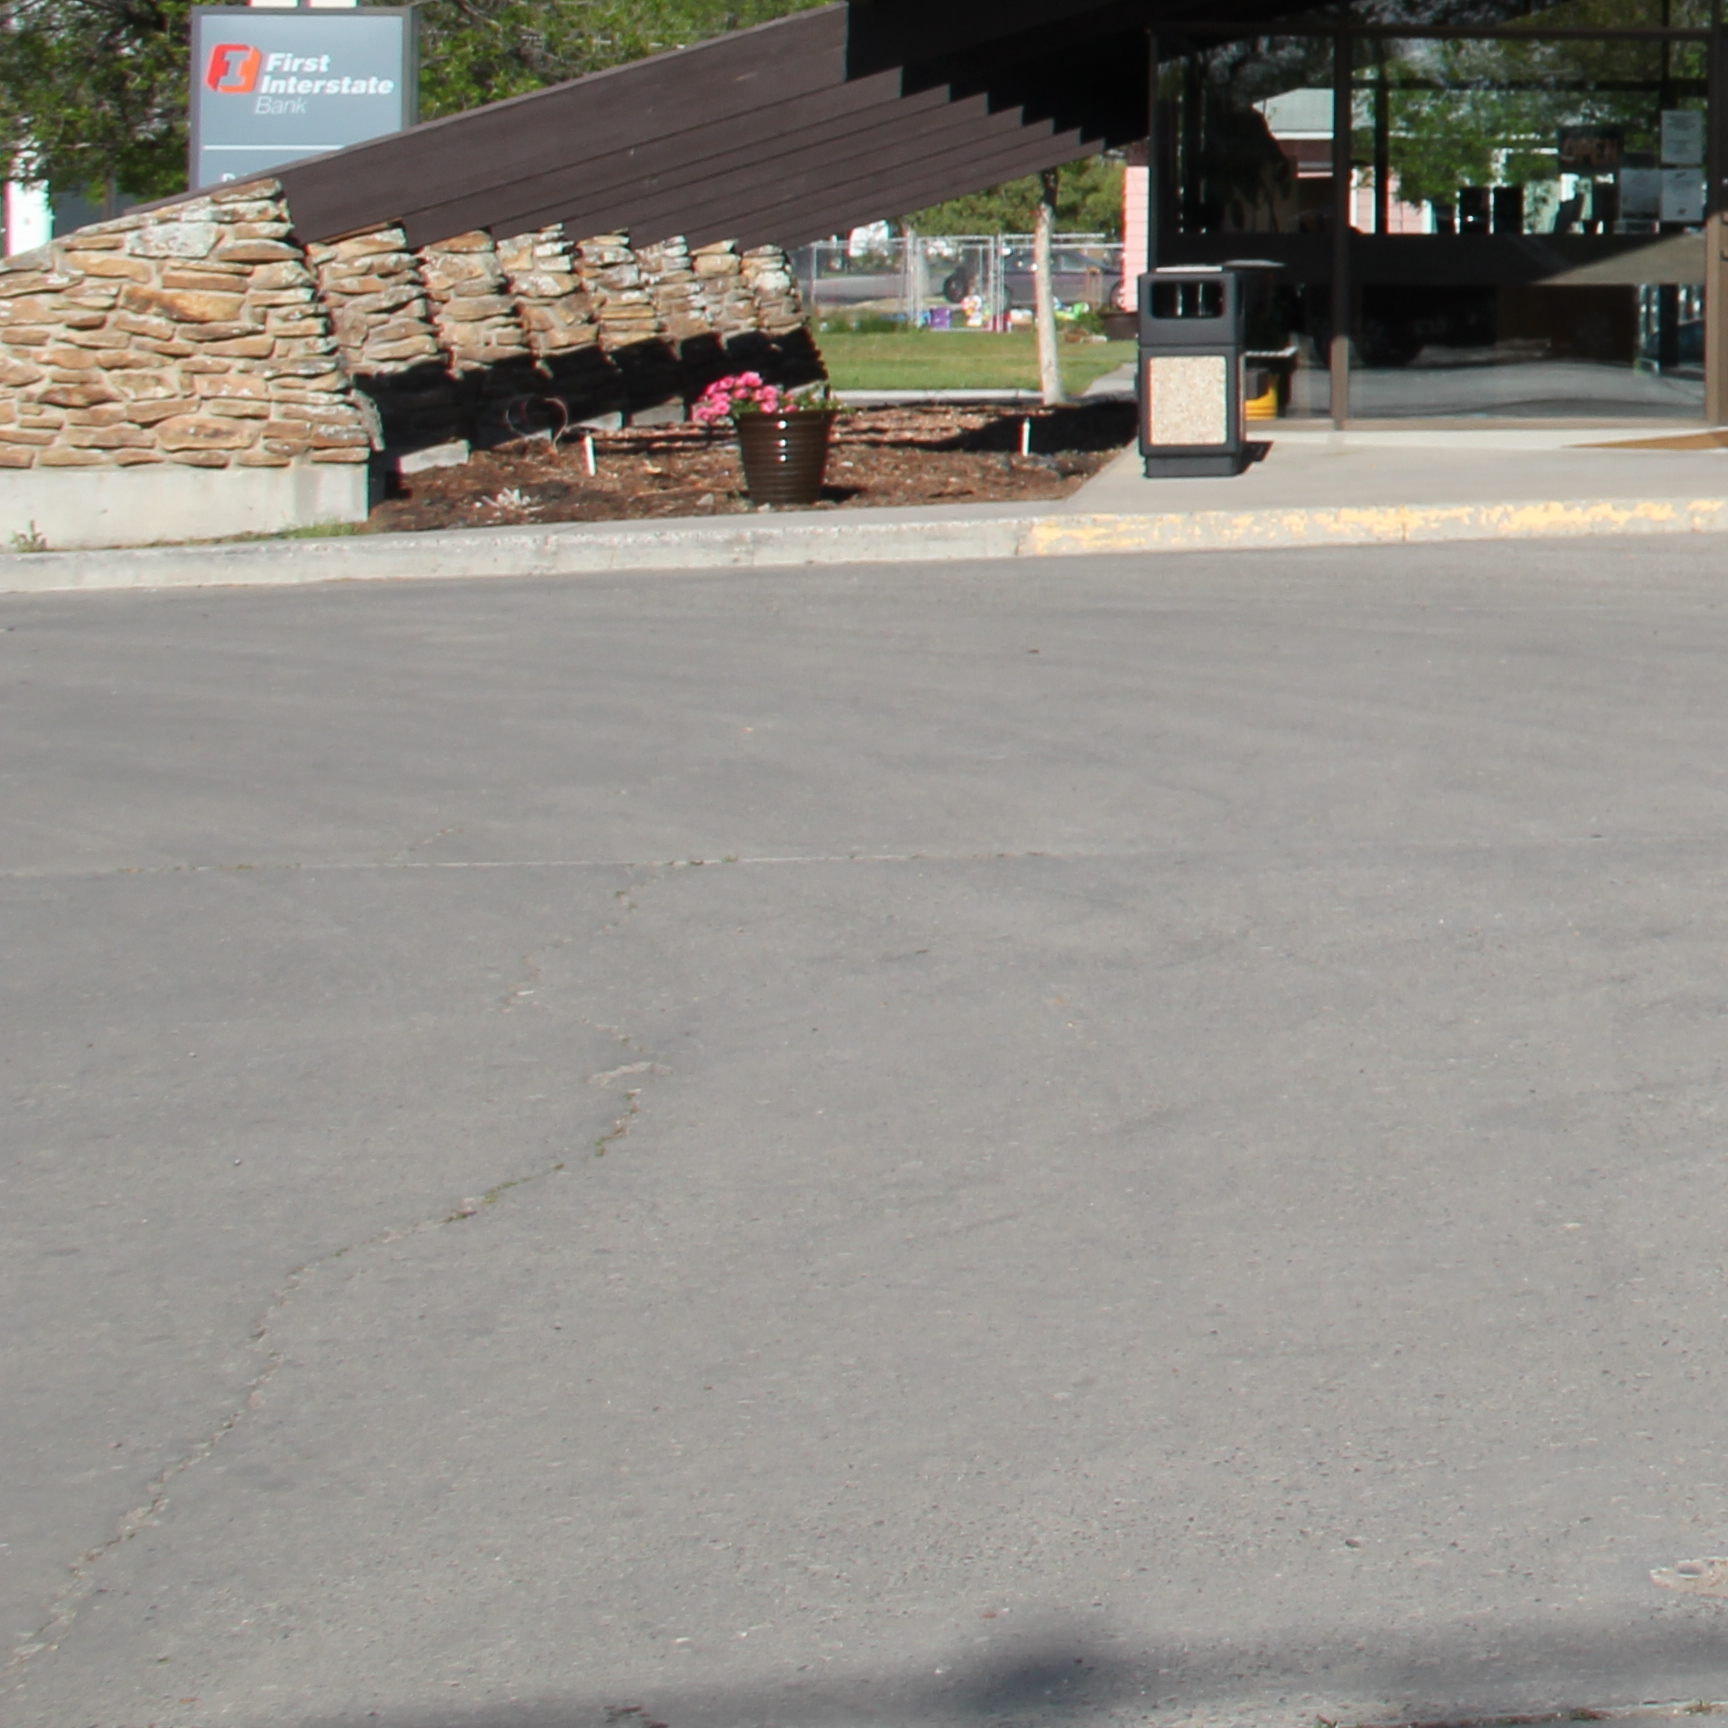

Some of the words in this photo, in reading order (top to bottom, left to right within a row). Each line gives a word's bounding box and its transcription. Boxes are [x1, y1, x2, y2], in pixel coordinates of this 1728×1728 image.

[265, 53, 331, 72] First
[260, 75, 394, 95] Interstate
[254, 96, 307, 114] Bank
